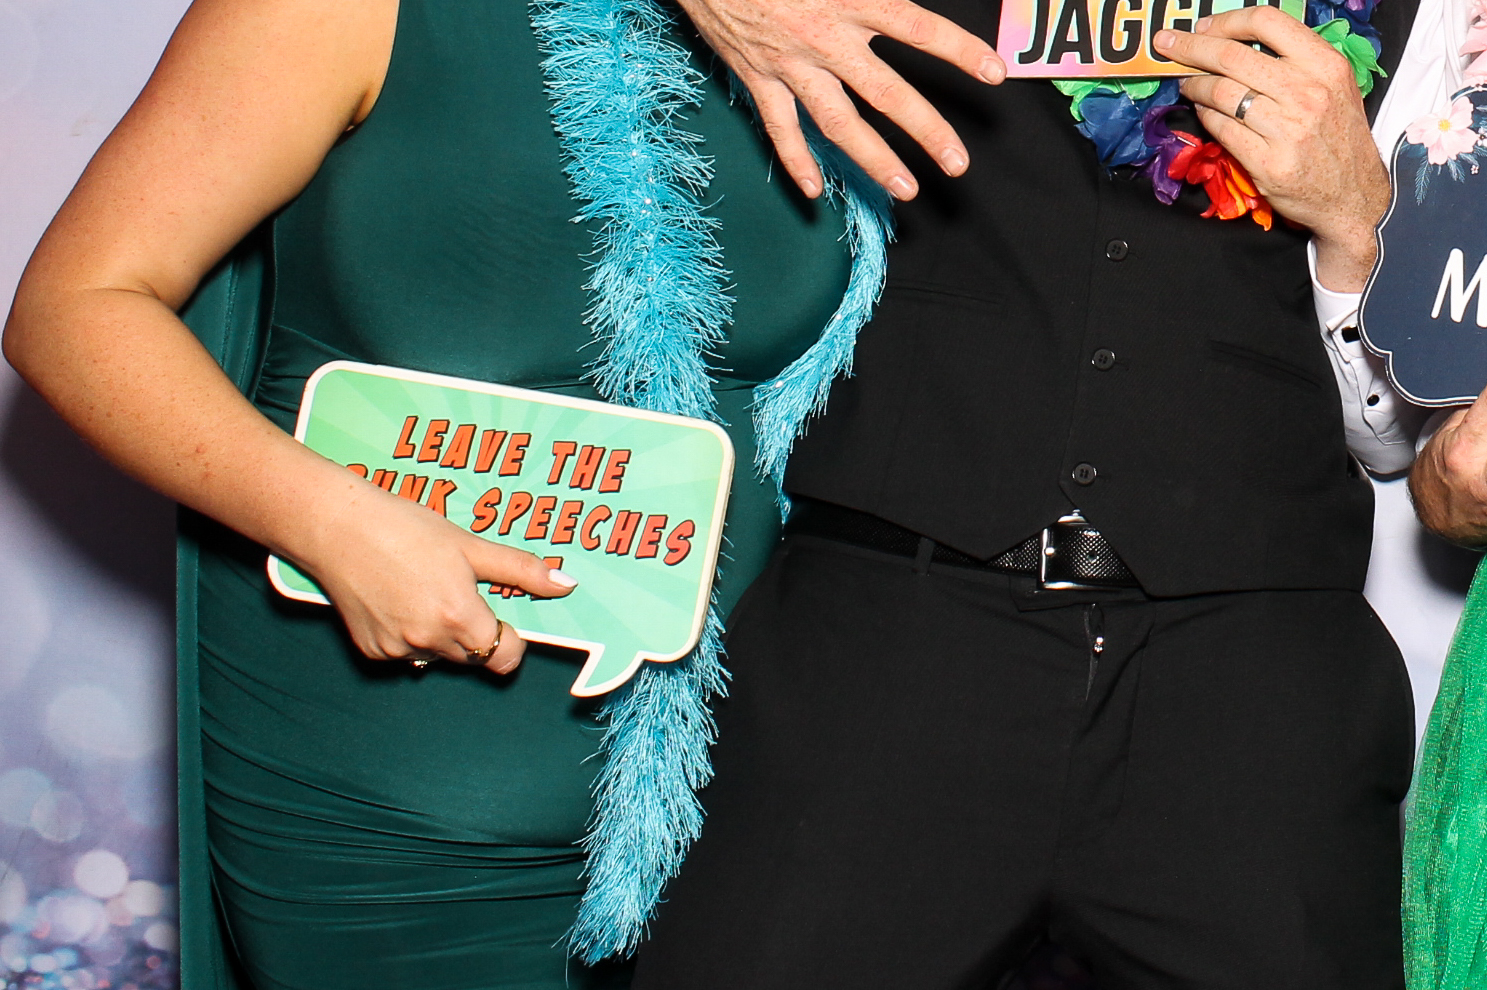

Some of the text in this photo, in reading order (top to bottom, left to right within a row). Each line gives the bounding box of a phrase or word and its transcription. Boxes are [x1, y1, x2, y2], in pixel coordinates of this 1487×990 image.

[392, 415, 632, 493] LEAVE THE
[469, 487, 696, 566] SPEECHES
